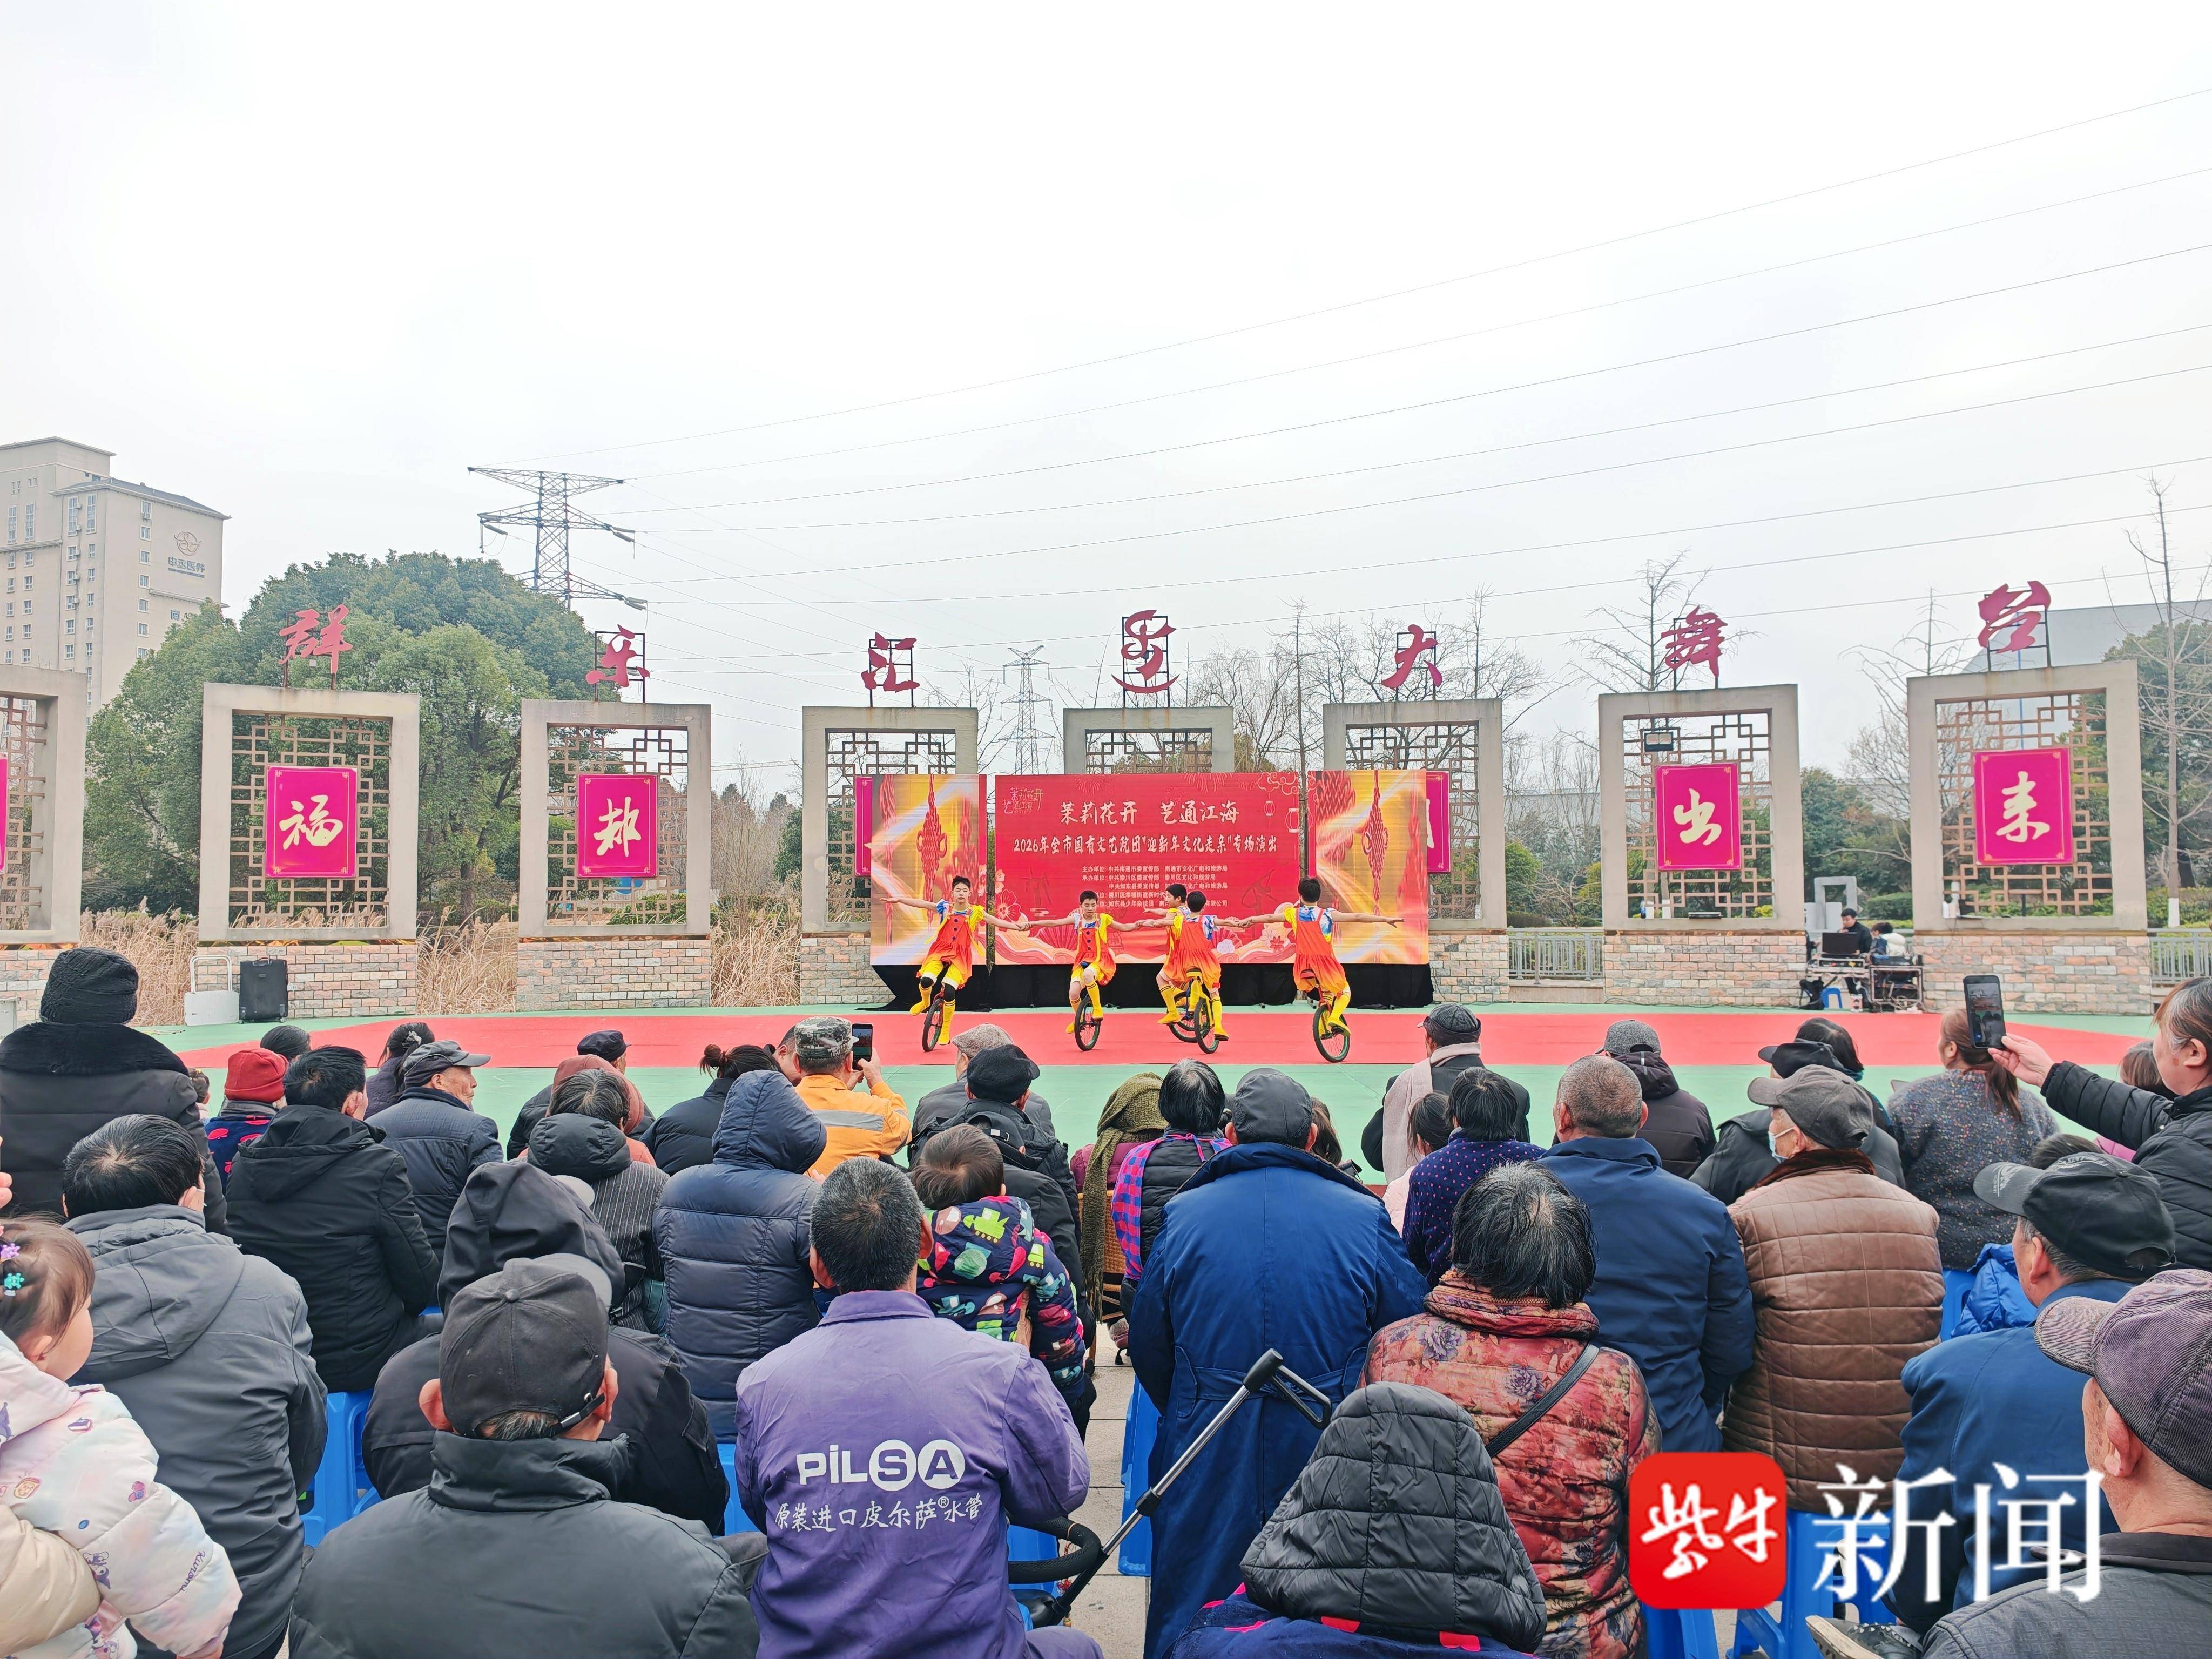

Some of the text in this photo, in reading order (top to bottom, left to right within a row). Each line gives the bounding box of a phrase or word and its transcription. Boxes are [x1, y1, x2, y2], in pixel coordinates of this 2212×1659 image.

[280, 604, 353, 674] 群
[1381, 624, 1442, 689] 大
[1661, 606, 1728, 679] 舞
[1978, 581, 2051, 653] 台
[279, 794, 343, 851] 福
[1673, 788, 1722, 846] 出
[1060, 799, 1239, 825] 茉莉花开 艺通江海
[179, 1550, 206, 1592] Kuromi
